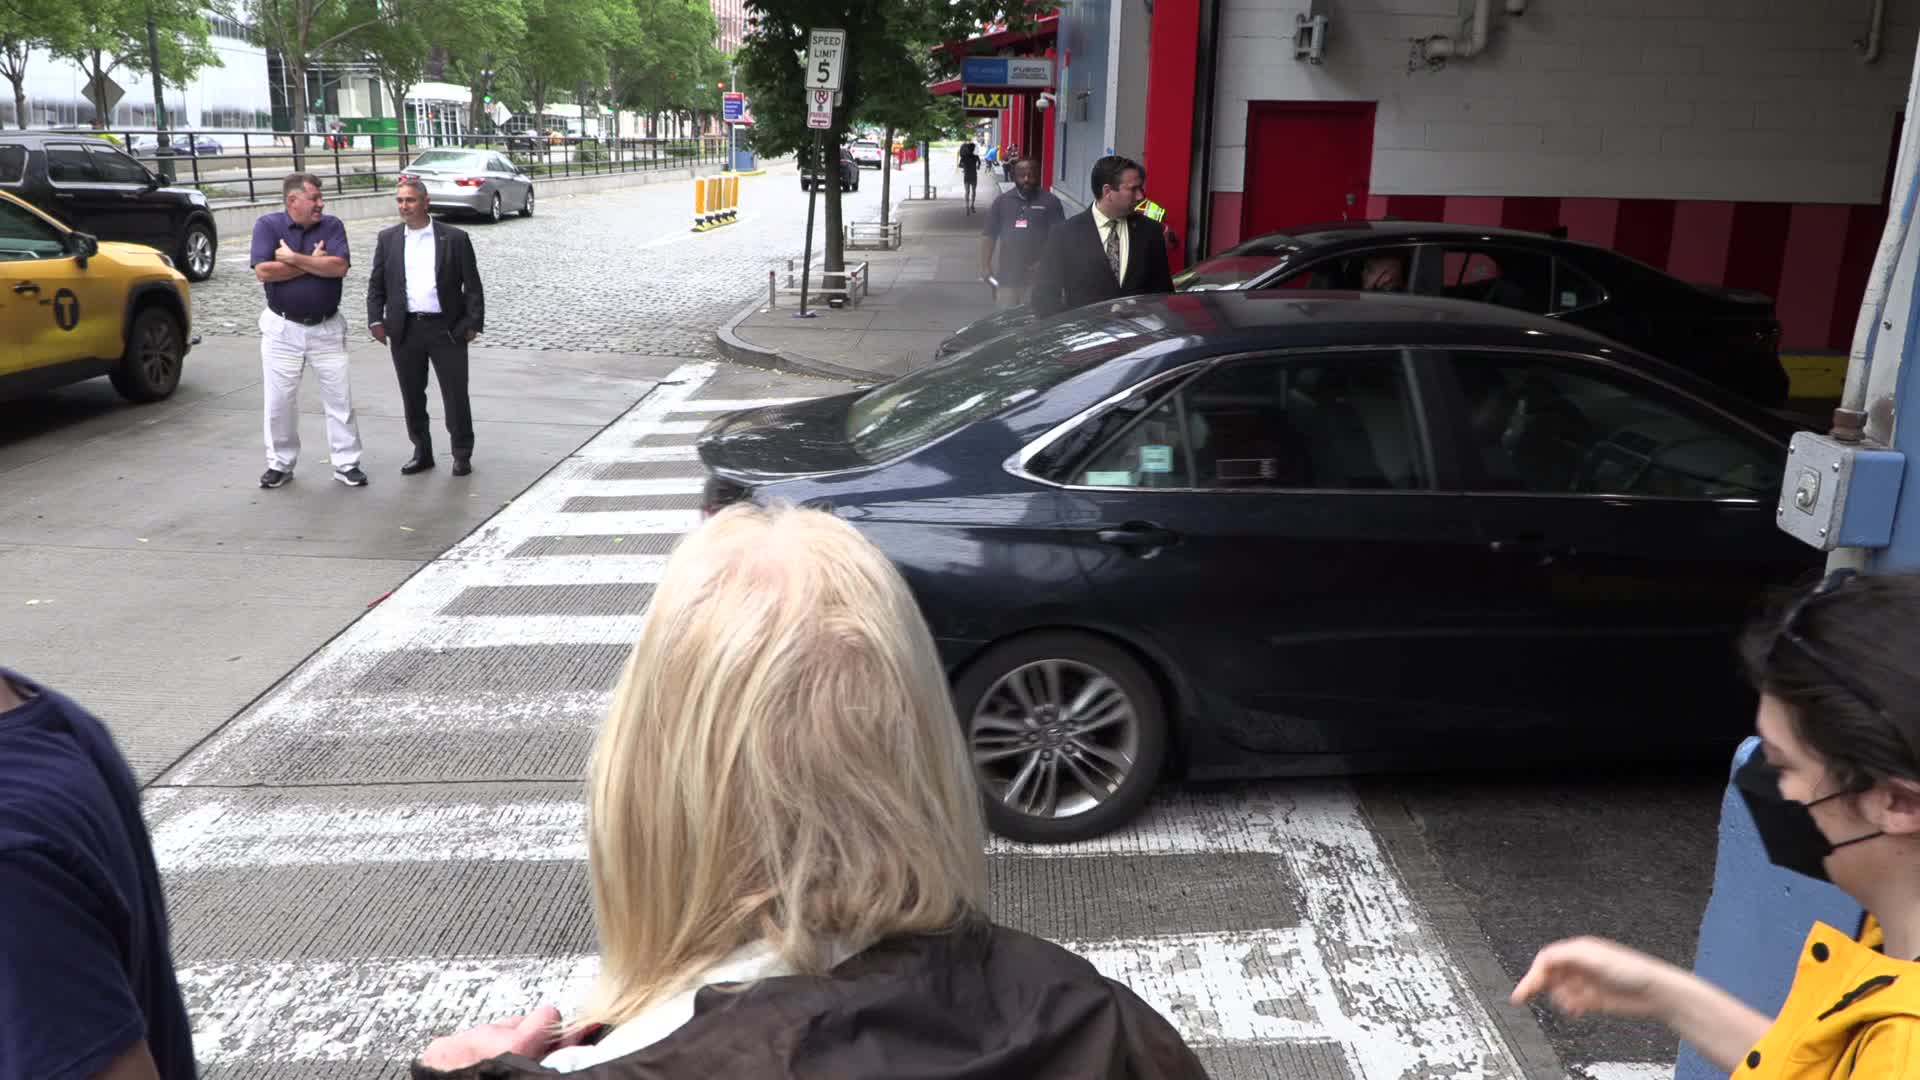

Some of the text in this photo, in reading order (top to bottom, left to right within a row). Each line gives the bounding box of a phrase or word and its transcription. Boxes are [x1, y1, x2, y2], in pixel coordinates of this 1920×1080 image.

[812, 36, 841, 46] SPEED
[814, 49, 837, 58] LIMIT
[816, 62, 830, 83] 5
[967, 93, 1008, 107] TAXI
